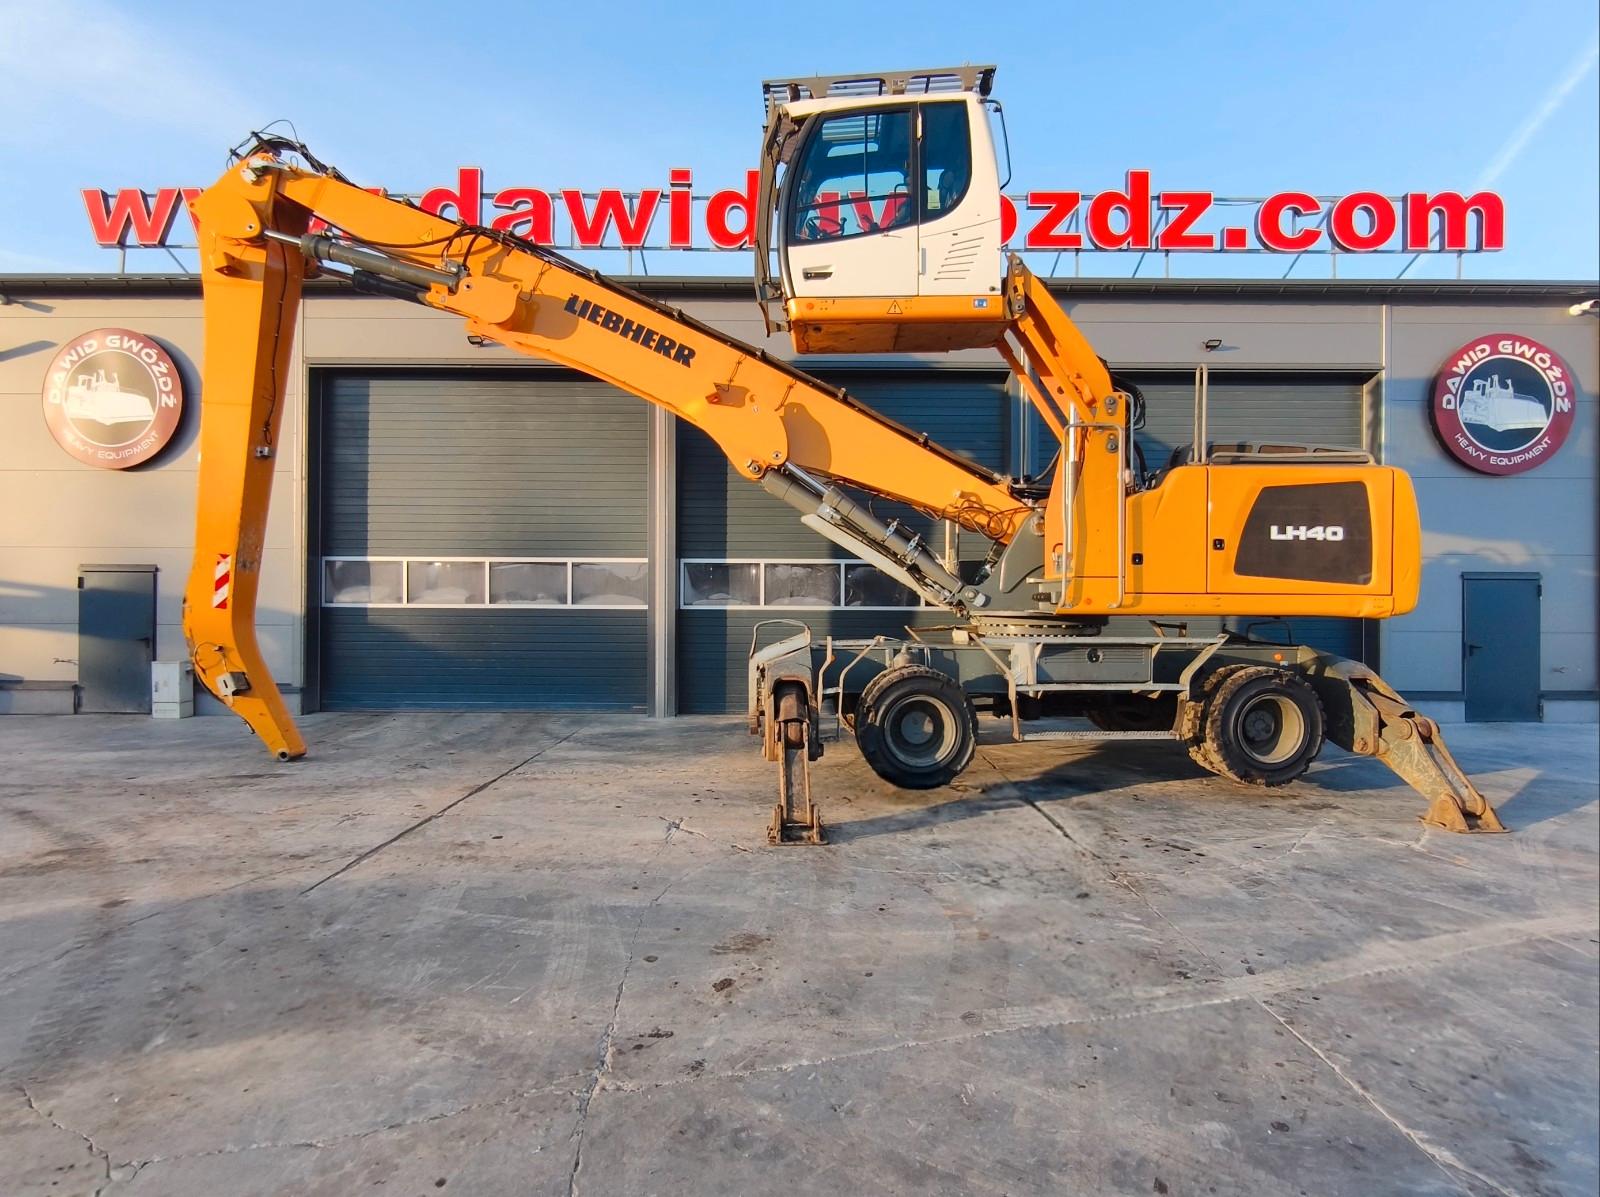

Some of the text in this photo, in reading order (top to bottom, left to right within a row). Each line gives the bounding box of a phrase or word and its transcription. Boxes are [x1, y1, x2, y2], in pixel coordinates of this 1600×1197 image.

[564, 293, 696, 368] LIEBHERR
[50, 339, 98, 404] DAWID
[1442, 344, 1490, 410] DAWID
[63, 429, 159, 460] AVY EQUIPMENT
[1454, 433, 1551, 466] HEAVY EQUIPMENT
[1270, 525, 1344, 541] LH40
